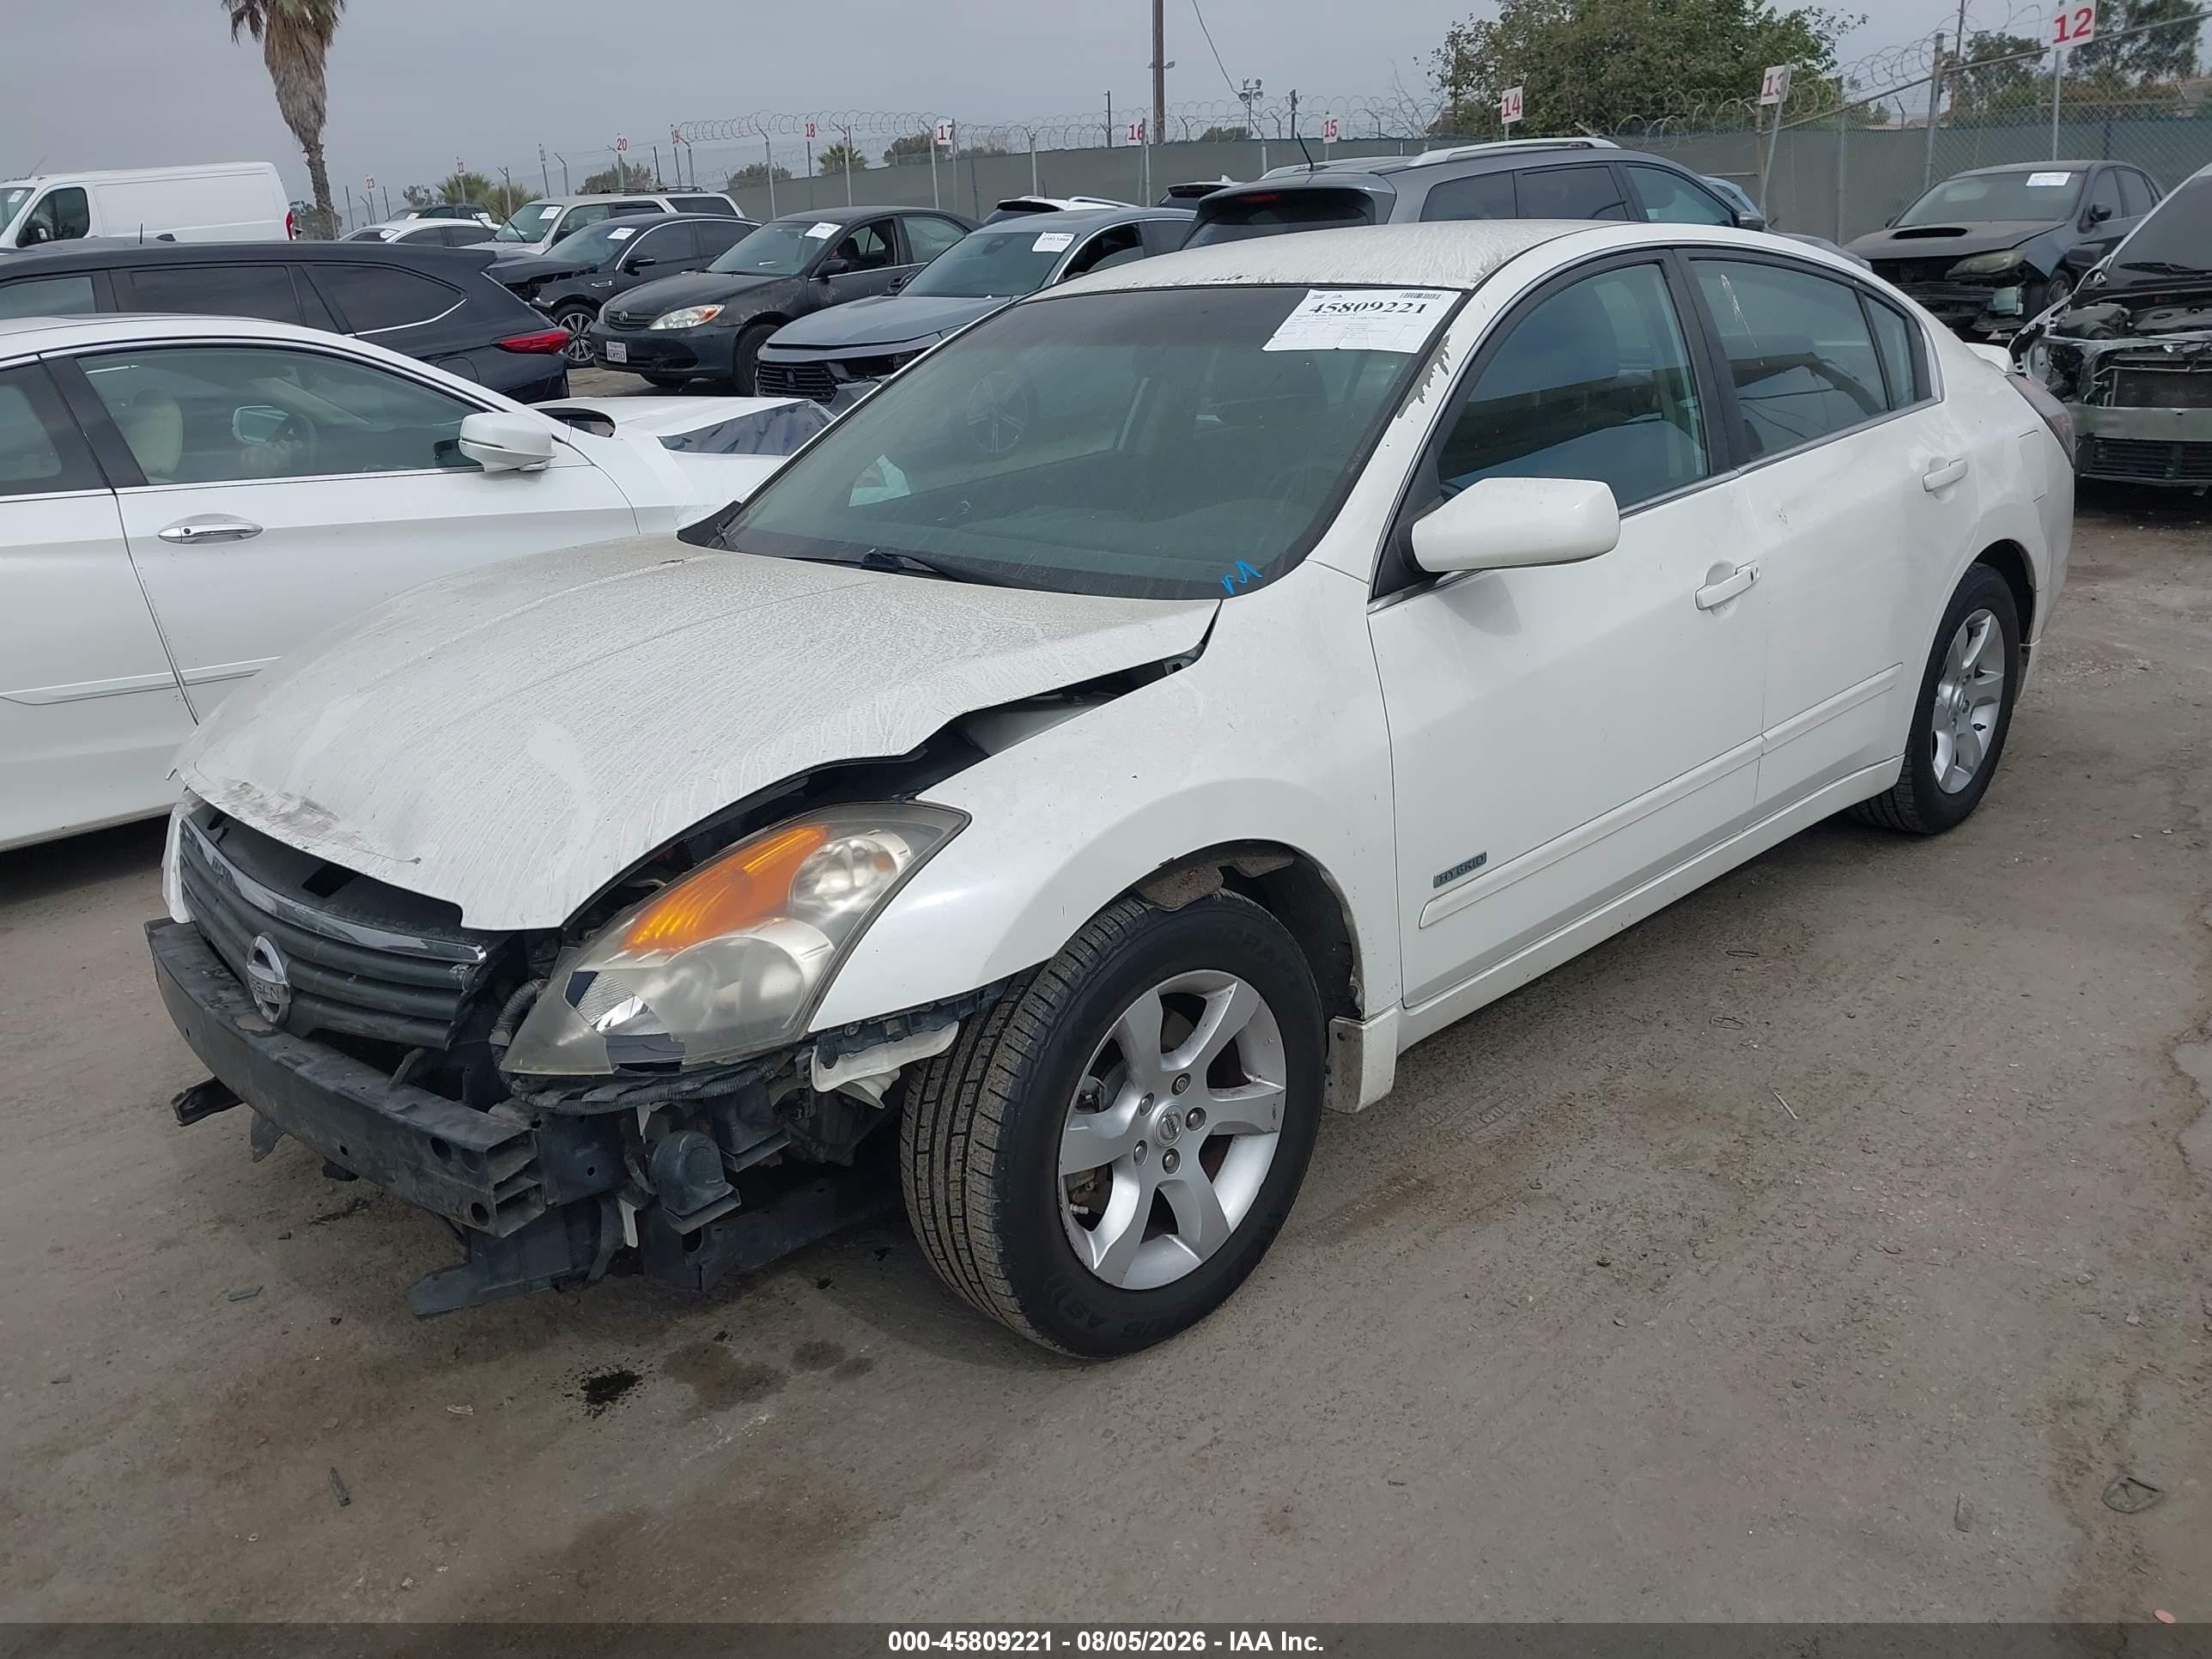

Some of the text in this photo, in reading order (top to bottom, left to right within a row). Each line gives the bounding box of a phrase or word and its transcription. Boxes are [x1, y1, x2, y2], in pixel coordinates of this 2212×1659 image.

[2053, 7, 2093, 44] 12
[1503, 94, 1521, 118] 14
[805, 123, 815, 137] 18
[938, 124, 954, 140] 17
[1324, 118, 1339, 137] 15
[617, 137, 628, 150] 20
[671, 130, 679, 144] 19
[1309, 301, 1429, 314] 45809221
[1439, 854, 1484, 884] HYBRID
